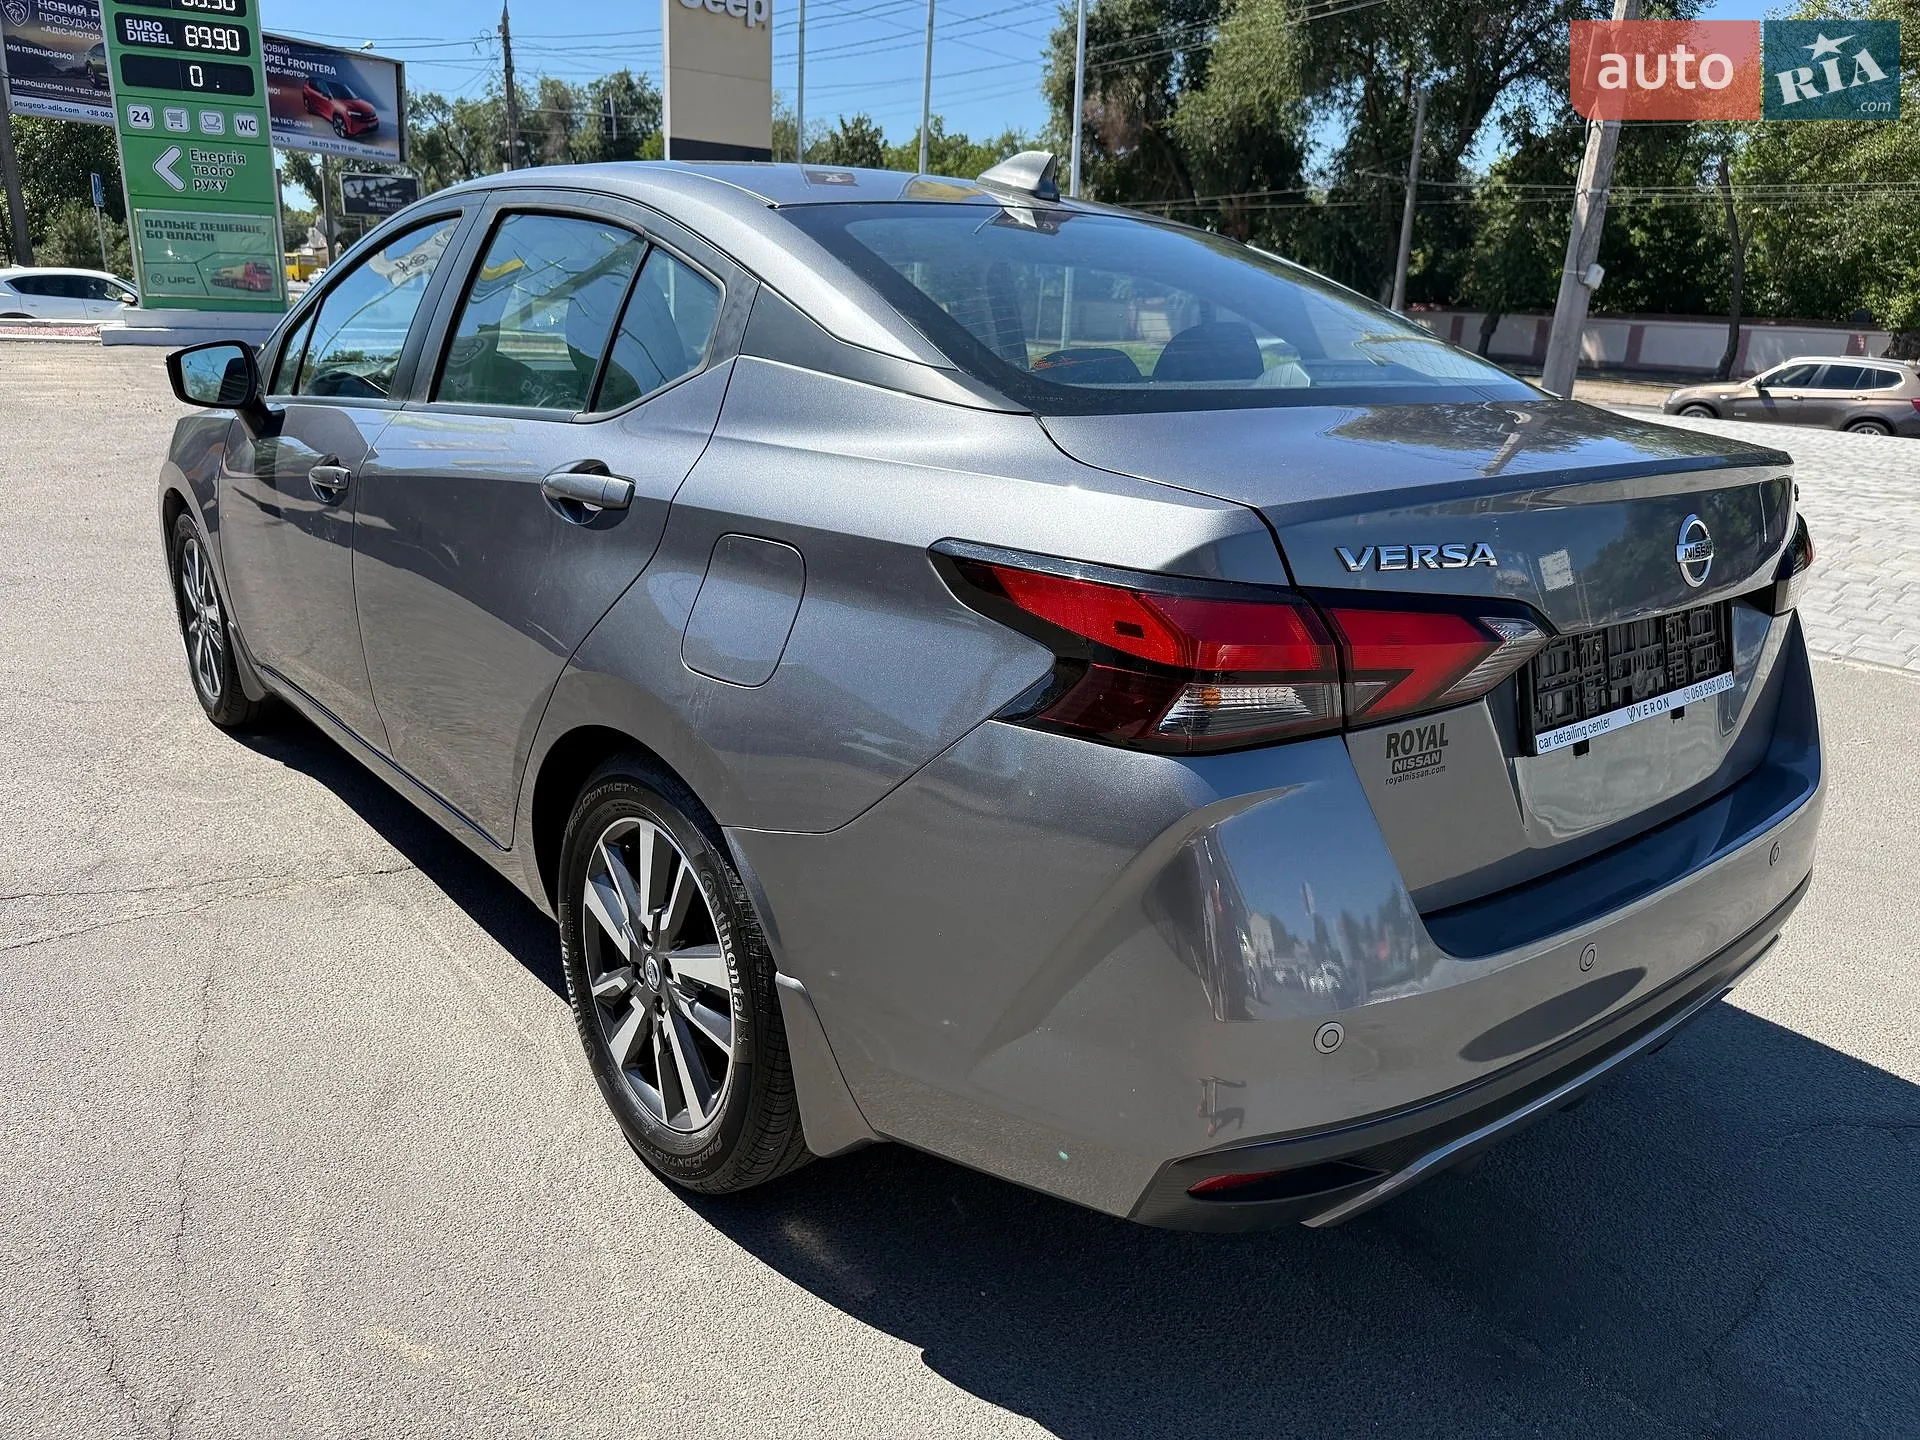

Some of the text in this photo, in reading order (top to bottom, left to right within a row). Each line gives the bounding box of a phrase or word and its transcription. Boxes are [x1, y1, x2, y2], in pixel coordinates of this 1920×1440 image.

[38, 0, 87, 17] НОВИЙ
[680, 0, 769, 28] eep
[39, 12, 101, 31] ПРОБУДЖУ
[125, 19, 163, 32] EURO
[41, 25, 103, 41] «АДІС-МОТОР
[127, 30, 174, 45] DIESEL
[6, 43, 20, 52] МИ
[287, 58, 337, 76] FRONTERA
[131, 110, 150, 123] 24
[237, 119, 257, 132] WC
[190, 149, 246, 165] Енергія
[192, 165, 235, 177] твого
[193, 179, 227, 192] руху
[144, 219, 266, 235] ПАЛЬНЕ ДЕШЕВШЕ,
[146, 230, 215, 242] БО ВЛАСНІ
[167, 276, 196, 285] UPG
[1335, 542, 1498, 572] VERSA
[1538, 738, 1552, 749] car
[1553, 725, 1587, 744] detailing
[1587, 718, 1611, 734] center
[1635, 697, 1670, 718] VERON
[1690, 685, 1704, 699] 068
[1716, 677, 1725, 690] 00
[1386, 723, 1448, 758] ROYAL
[1393, 751, 1441, 773] NISSAN
[1385, 765, 1446, 785] royalnissan.com
